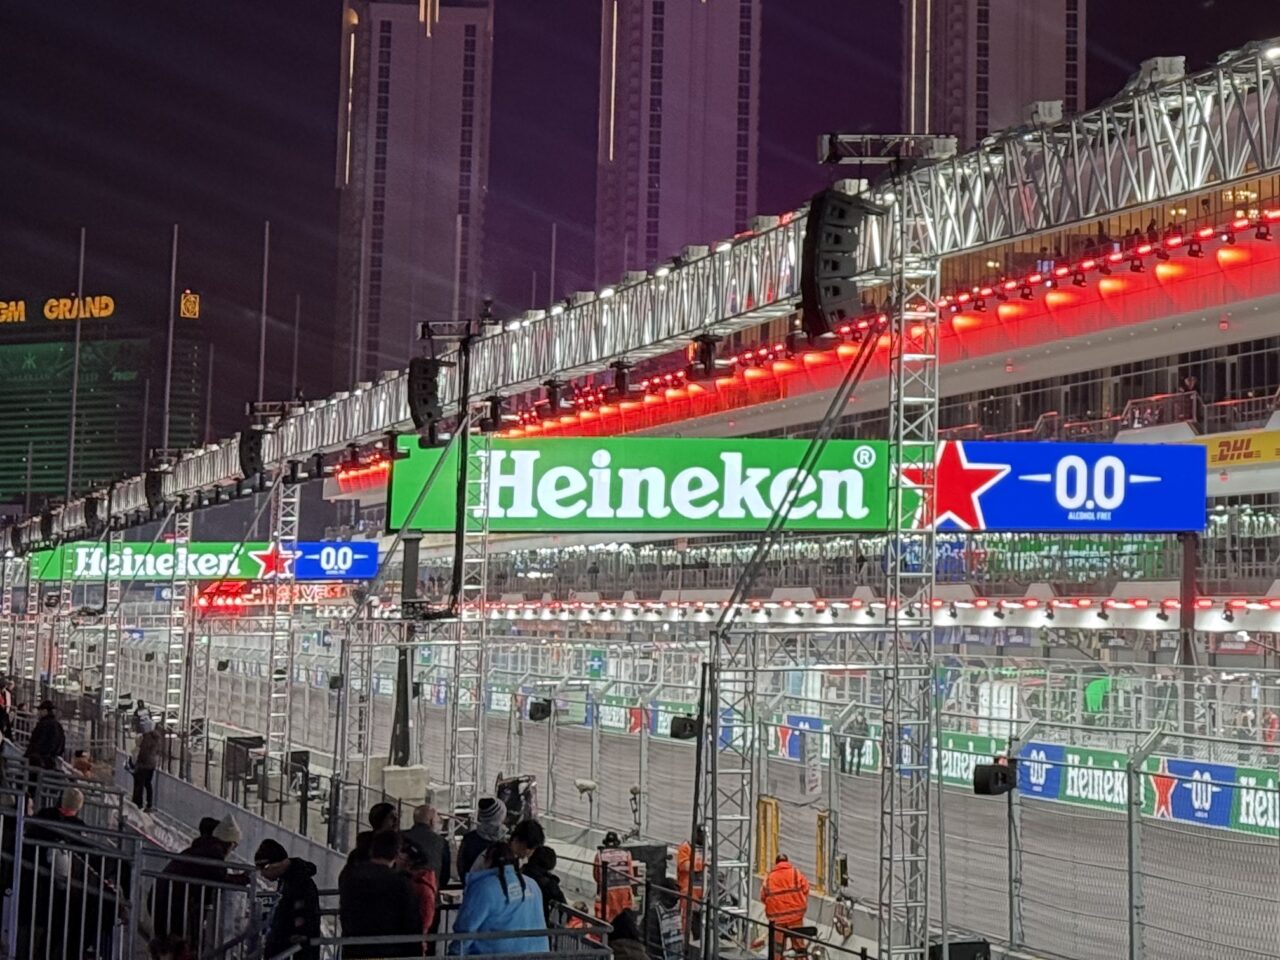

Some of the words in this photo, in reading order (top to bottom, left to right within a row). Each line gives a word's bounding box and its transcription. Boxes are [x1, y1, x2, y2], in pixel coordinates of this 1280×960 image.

[43, 295, 115, 320] GRAND
[1218, 438, 1254, 462] DHL
[476, 449, 870, 519] Heineken
[1055, 455, 1125, 510] 0.0
[1096, 511, 1112, 521] FREE
[73, 546, 242, 577] Heineken
[319, 547, 353, 572] 0.0
[1065, 753, 1147, 809] Heinek
[1191, 770, 1211, 810] 0.0
